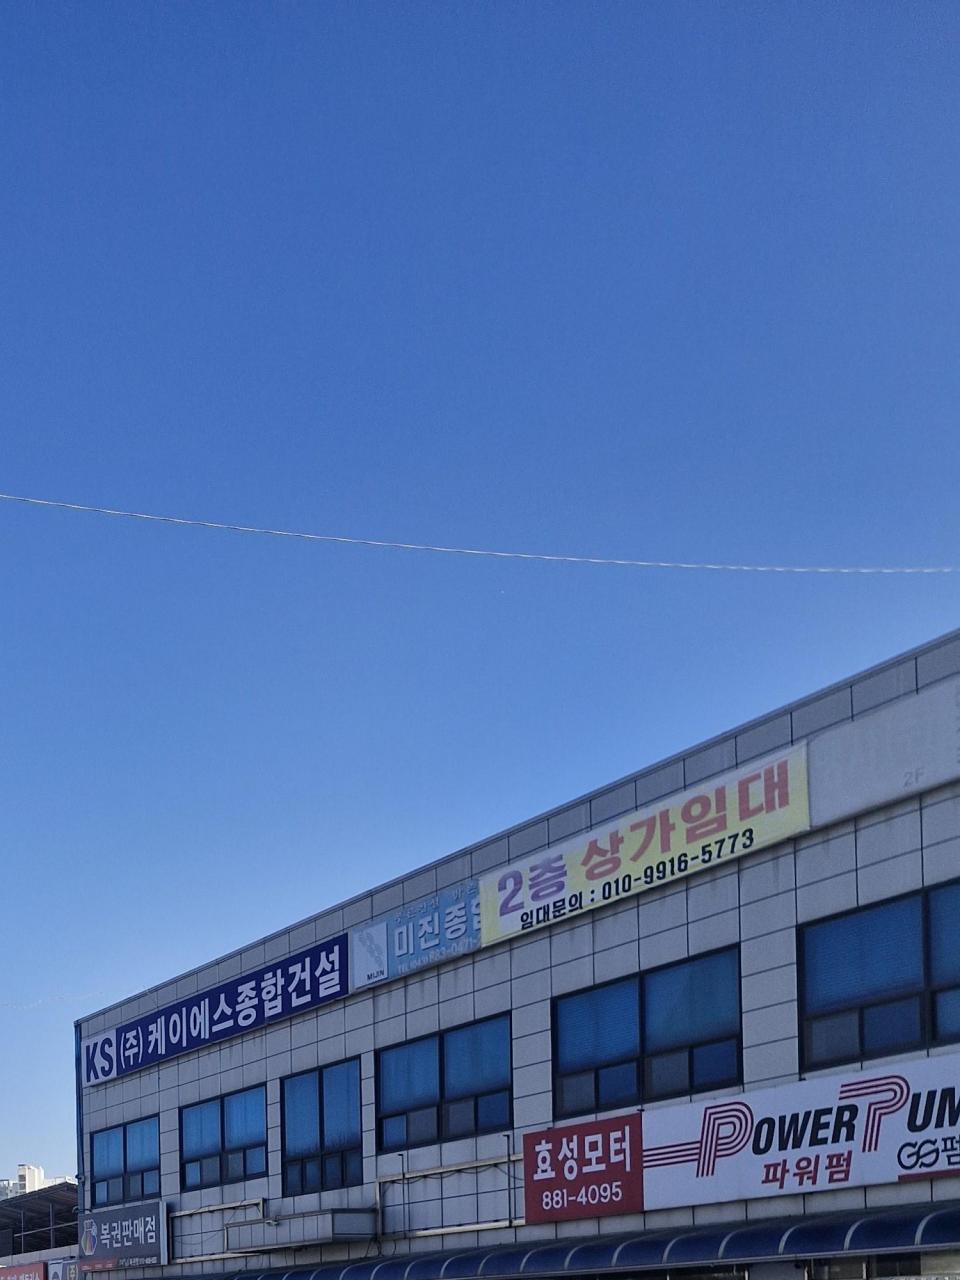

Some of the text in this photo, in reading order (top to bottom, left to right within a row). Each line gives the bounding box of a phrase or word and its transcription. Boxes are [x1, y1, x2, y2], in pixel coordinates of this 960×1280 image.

[497, 758, 790, 917] 2층 상가임대
[520, 891, 583, 931] 임대문의
[601, 827, 755, 901] 010-9916-5773
[85, 1035, 115, 1084] KS
[532, 1124, 632, 1182] 효성모터
[695, 1101, 859, 1178] POWER
[541, 1181, 623, 1210] 881-4095
[761, 1150, 853, 1190] 파워펌
[100, 1215, 157, 1249] 복권판매점
